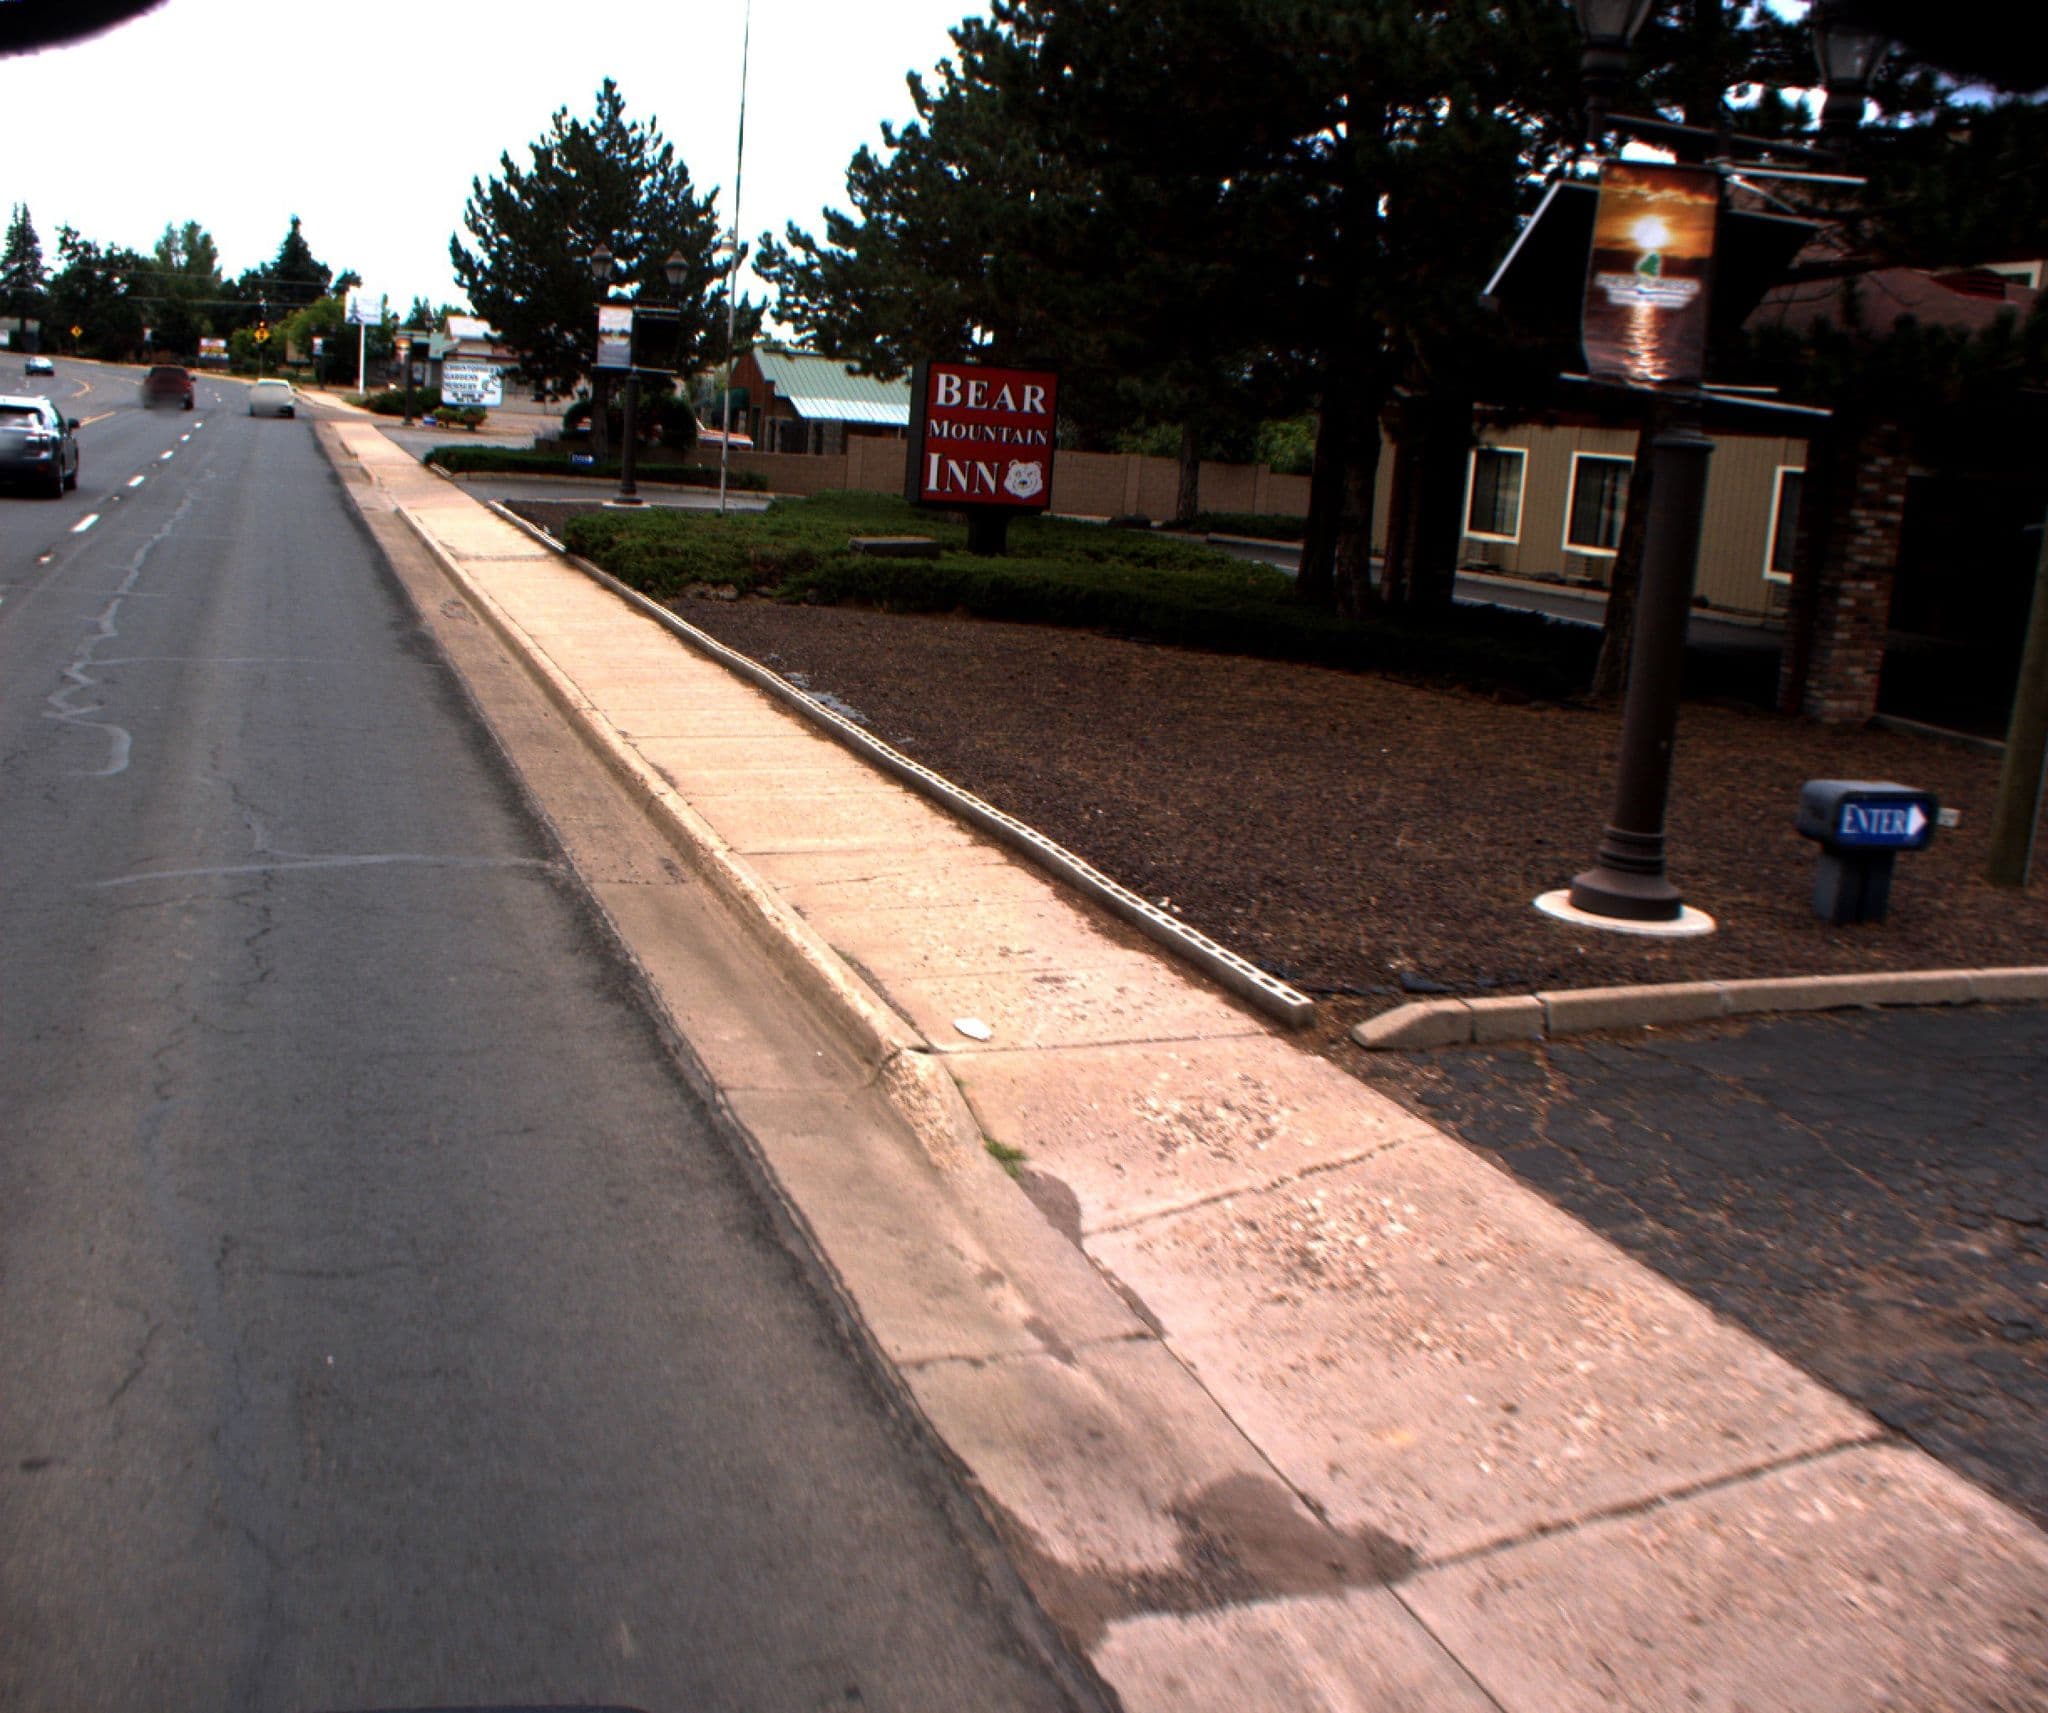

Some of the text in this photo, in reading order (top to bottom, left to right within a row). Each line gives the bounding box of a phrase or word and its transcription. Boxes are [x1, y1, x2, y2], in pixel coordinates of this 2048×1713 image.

[935, 372, 1047, 415] BEAR
[928, 418, 1049, 446] MOUNTAIN
[925, 452, 1000, 495] INN
[1840, 803, 1906, 834] ENTER
